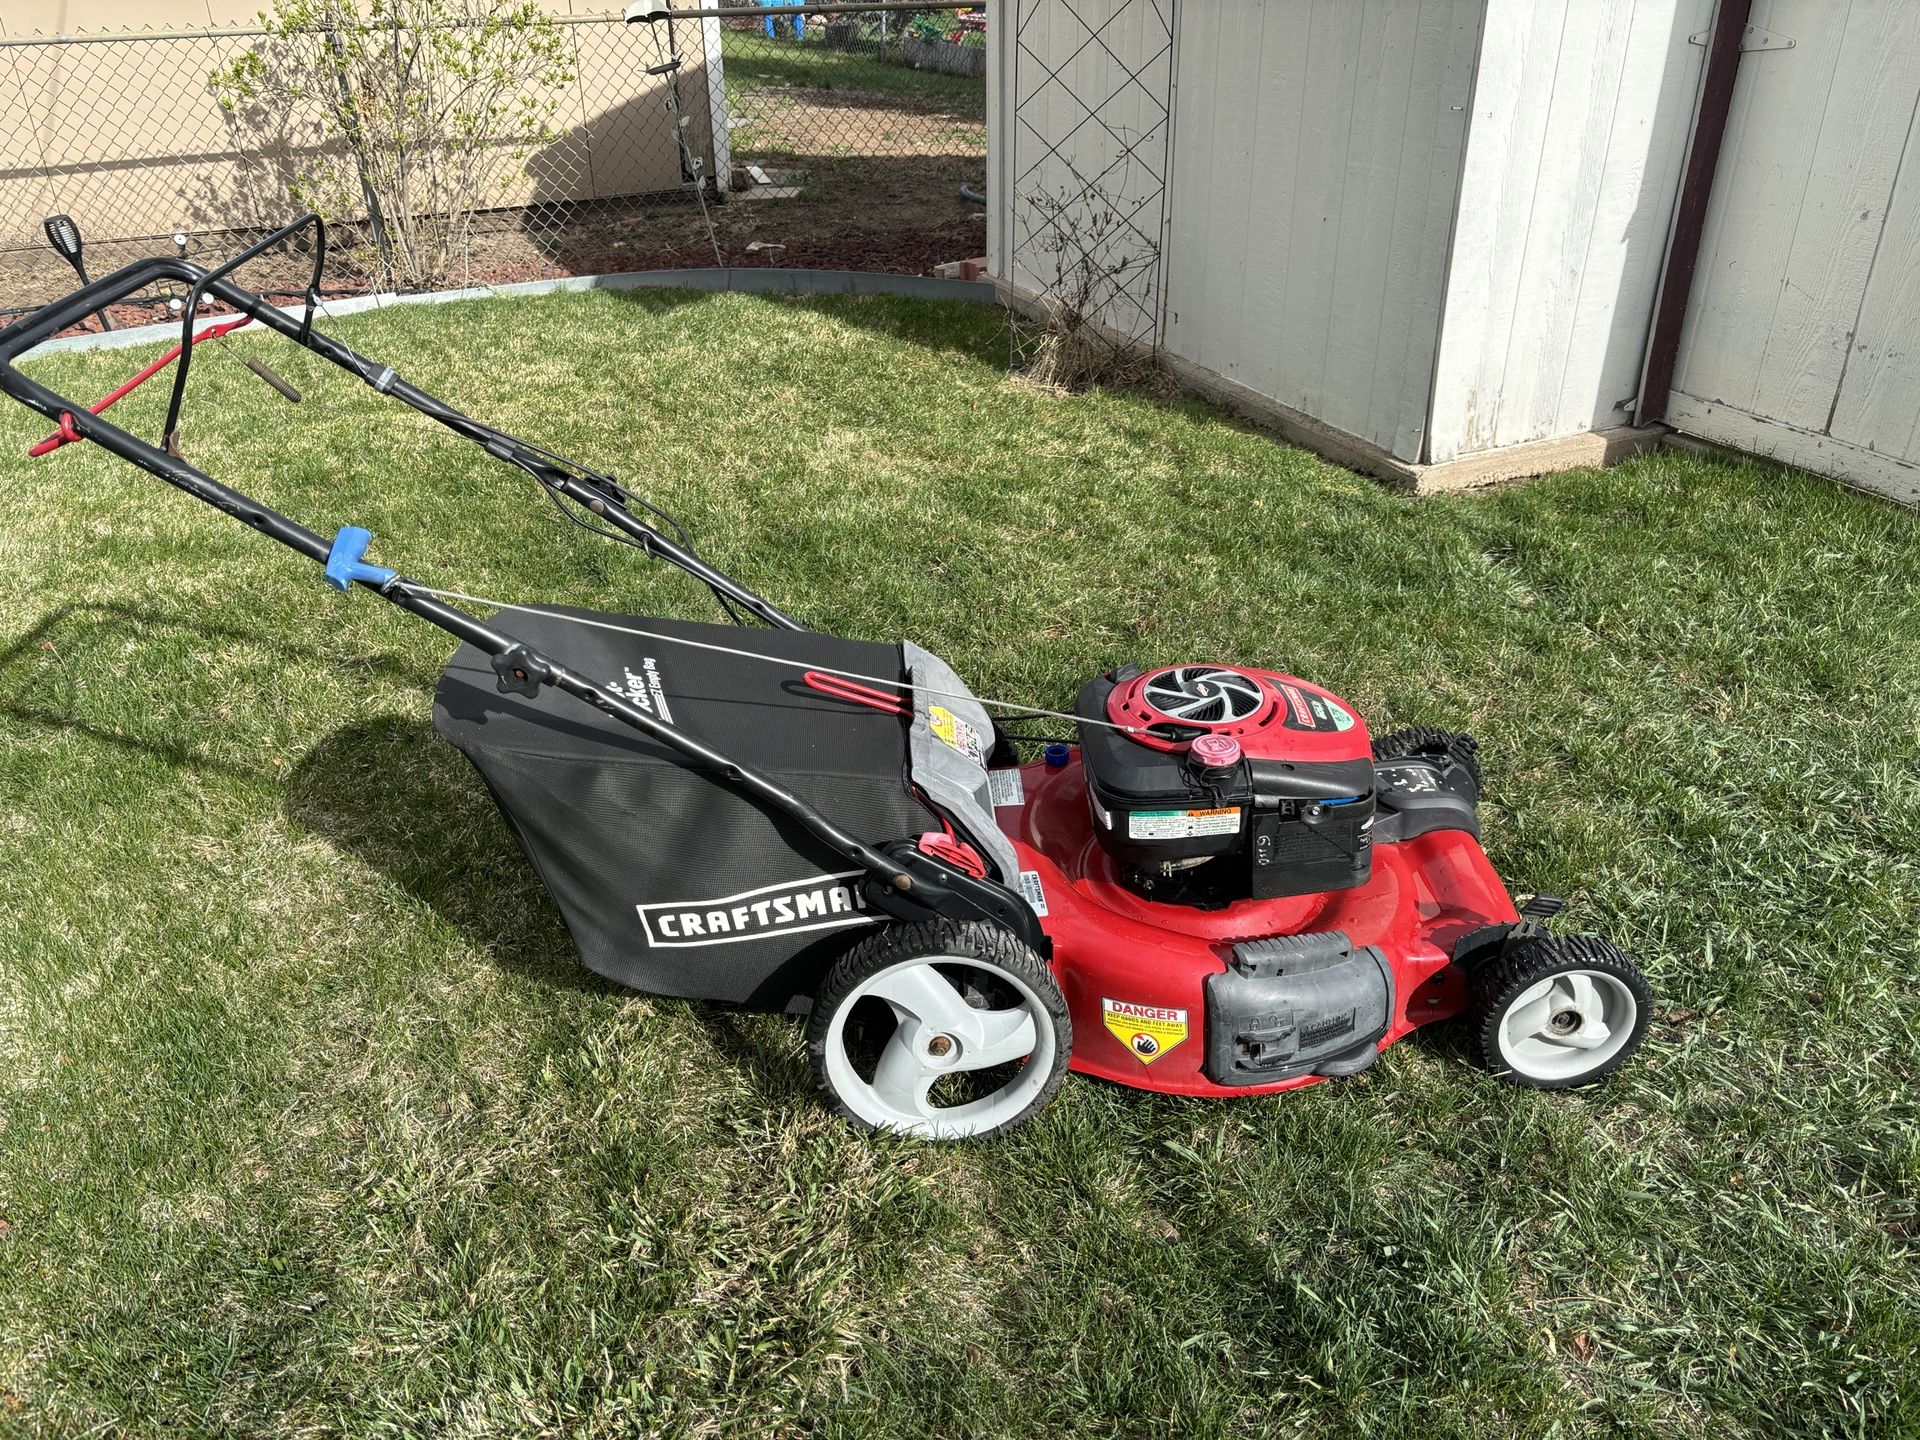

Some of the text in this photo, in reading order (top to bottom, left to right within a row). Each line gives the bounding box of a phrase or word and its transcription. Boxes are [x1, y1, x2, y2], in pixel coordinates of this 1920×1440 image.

[643, 658, 656, 670] Bag
[646, 670, 661, 688] Empty
[1200, 808, 1232, 817] WARNING
[1112, 1001, 1178, 1021] DANGER
[1107, 1012, 1119, 1020] KEEP
[1121, 1015, 1140, 1023] HANDS
